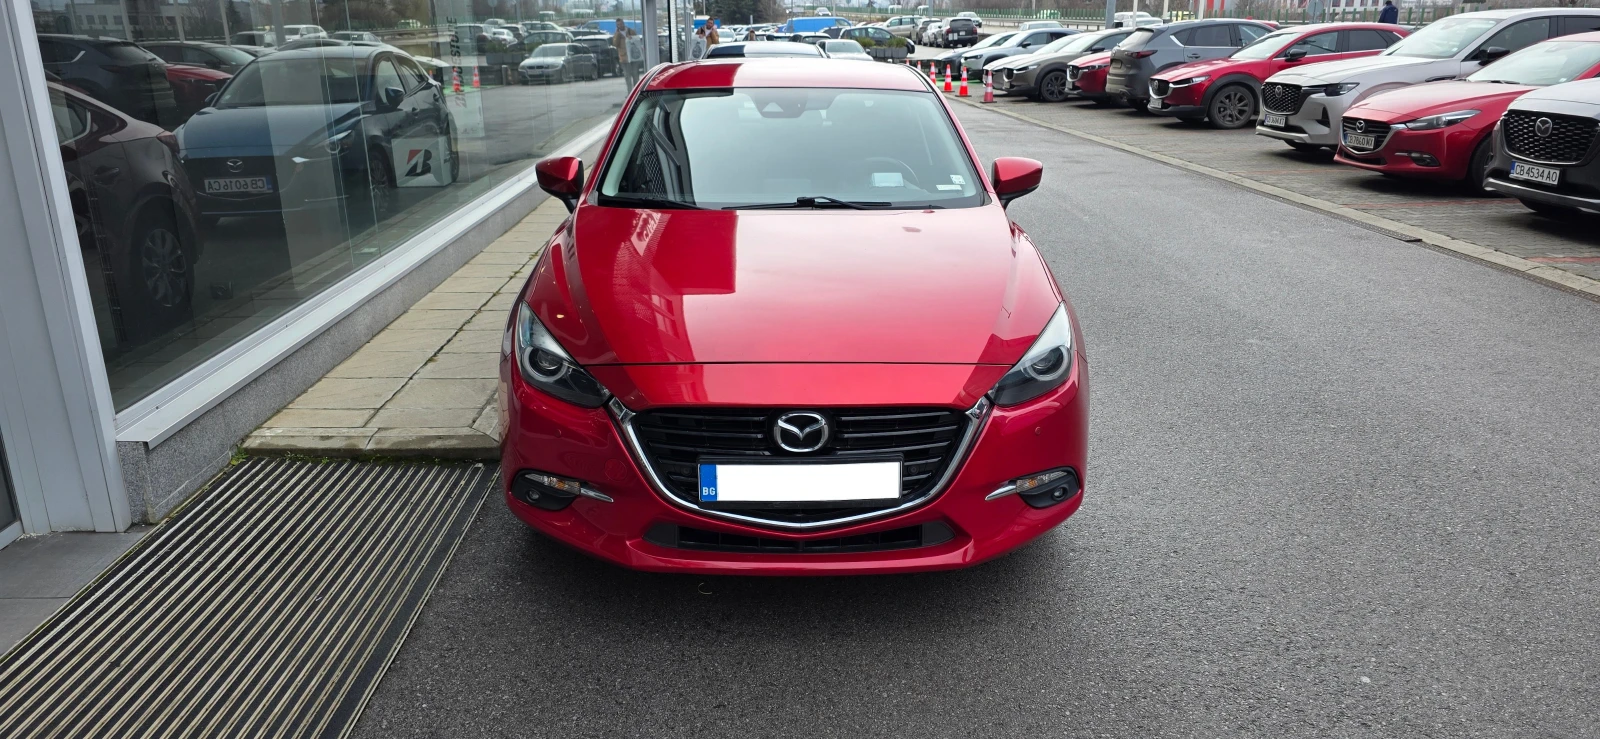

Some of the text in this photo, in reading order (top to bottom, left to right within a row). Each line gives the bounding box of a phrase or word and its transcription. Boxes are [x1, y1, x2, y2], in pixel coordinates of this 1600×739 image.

[1515, 164, 1557, 182] CB 4534 AO
[702, 486, 716, 496] BG
